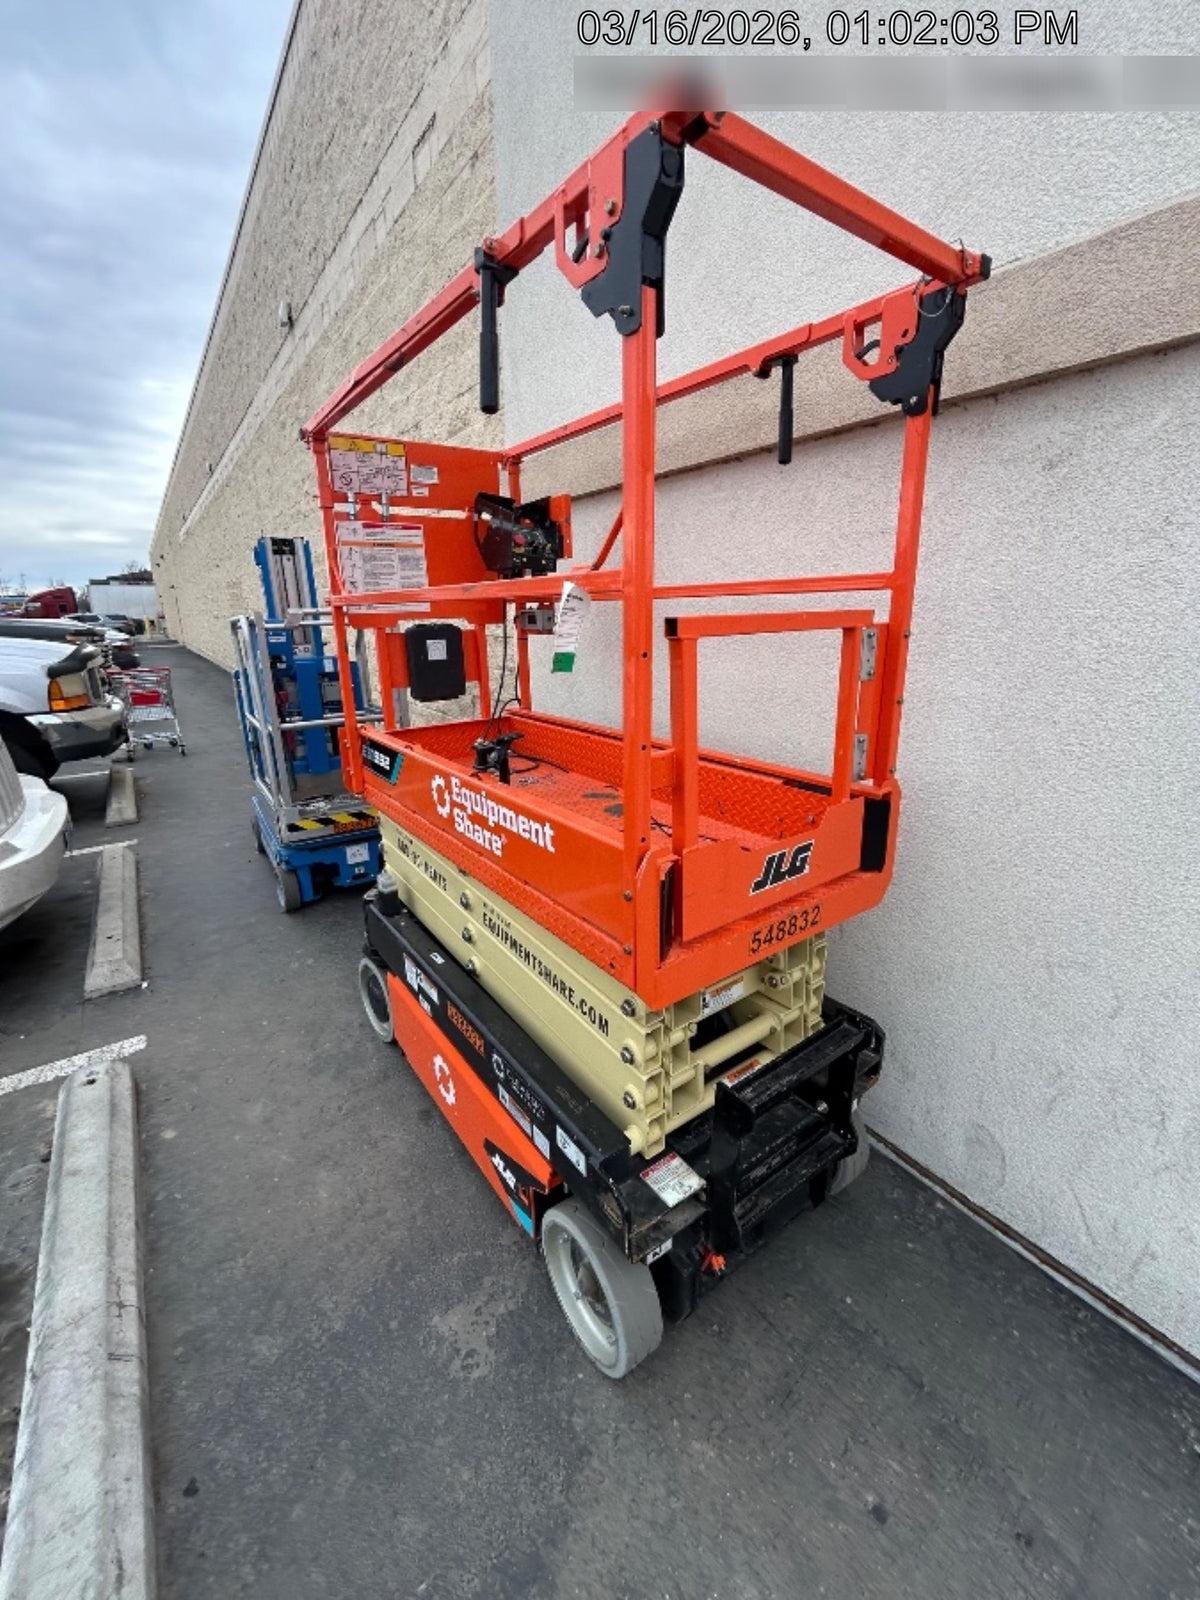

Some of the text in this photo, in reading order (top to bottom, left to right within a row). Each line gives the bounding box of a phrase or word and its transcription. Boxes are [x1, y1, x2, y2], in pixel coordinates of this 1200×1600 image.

[450, 776, 556, 853] Equipment
[750, 840, 815, 896] JLG
[751, 905, 822, 954] 548832
[482, 911, 610, 1038] EQUIPMENTSHARE.COM
